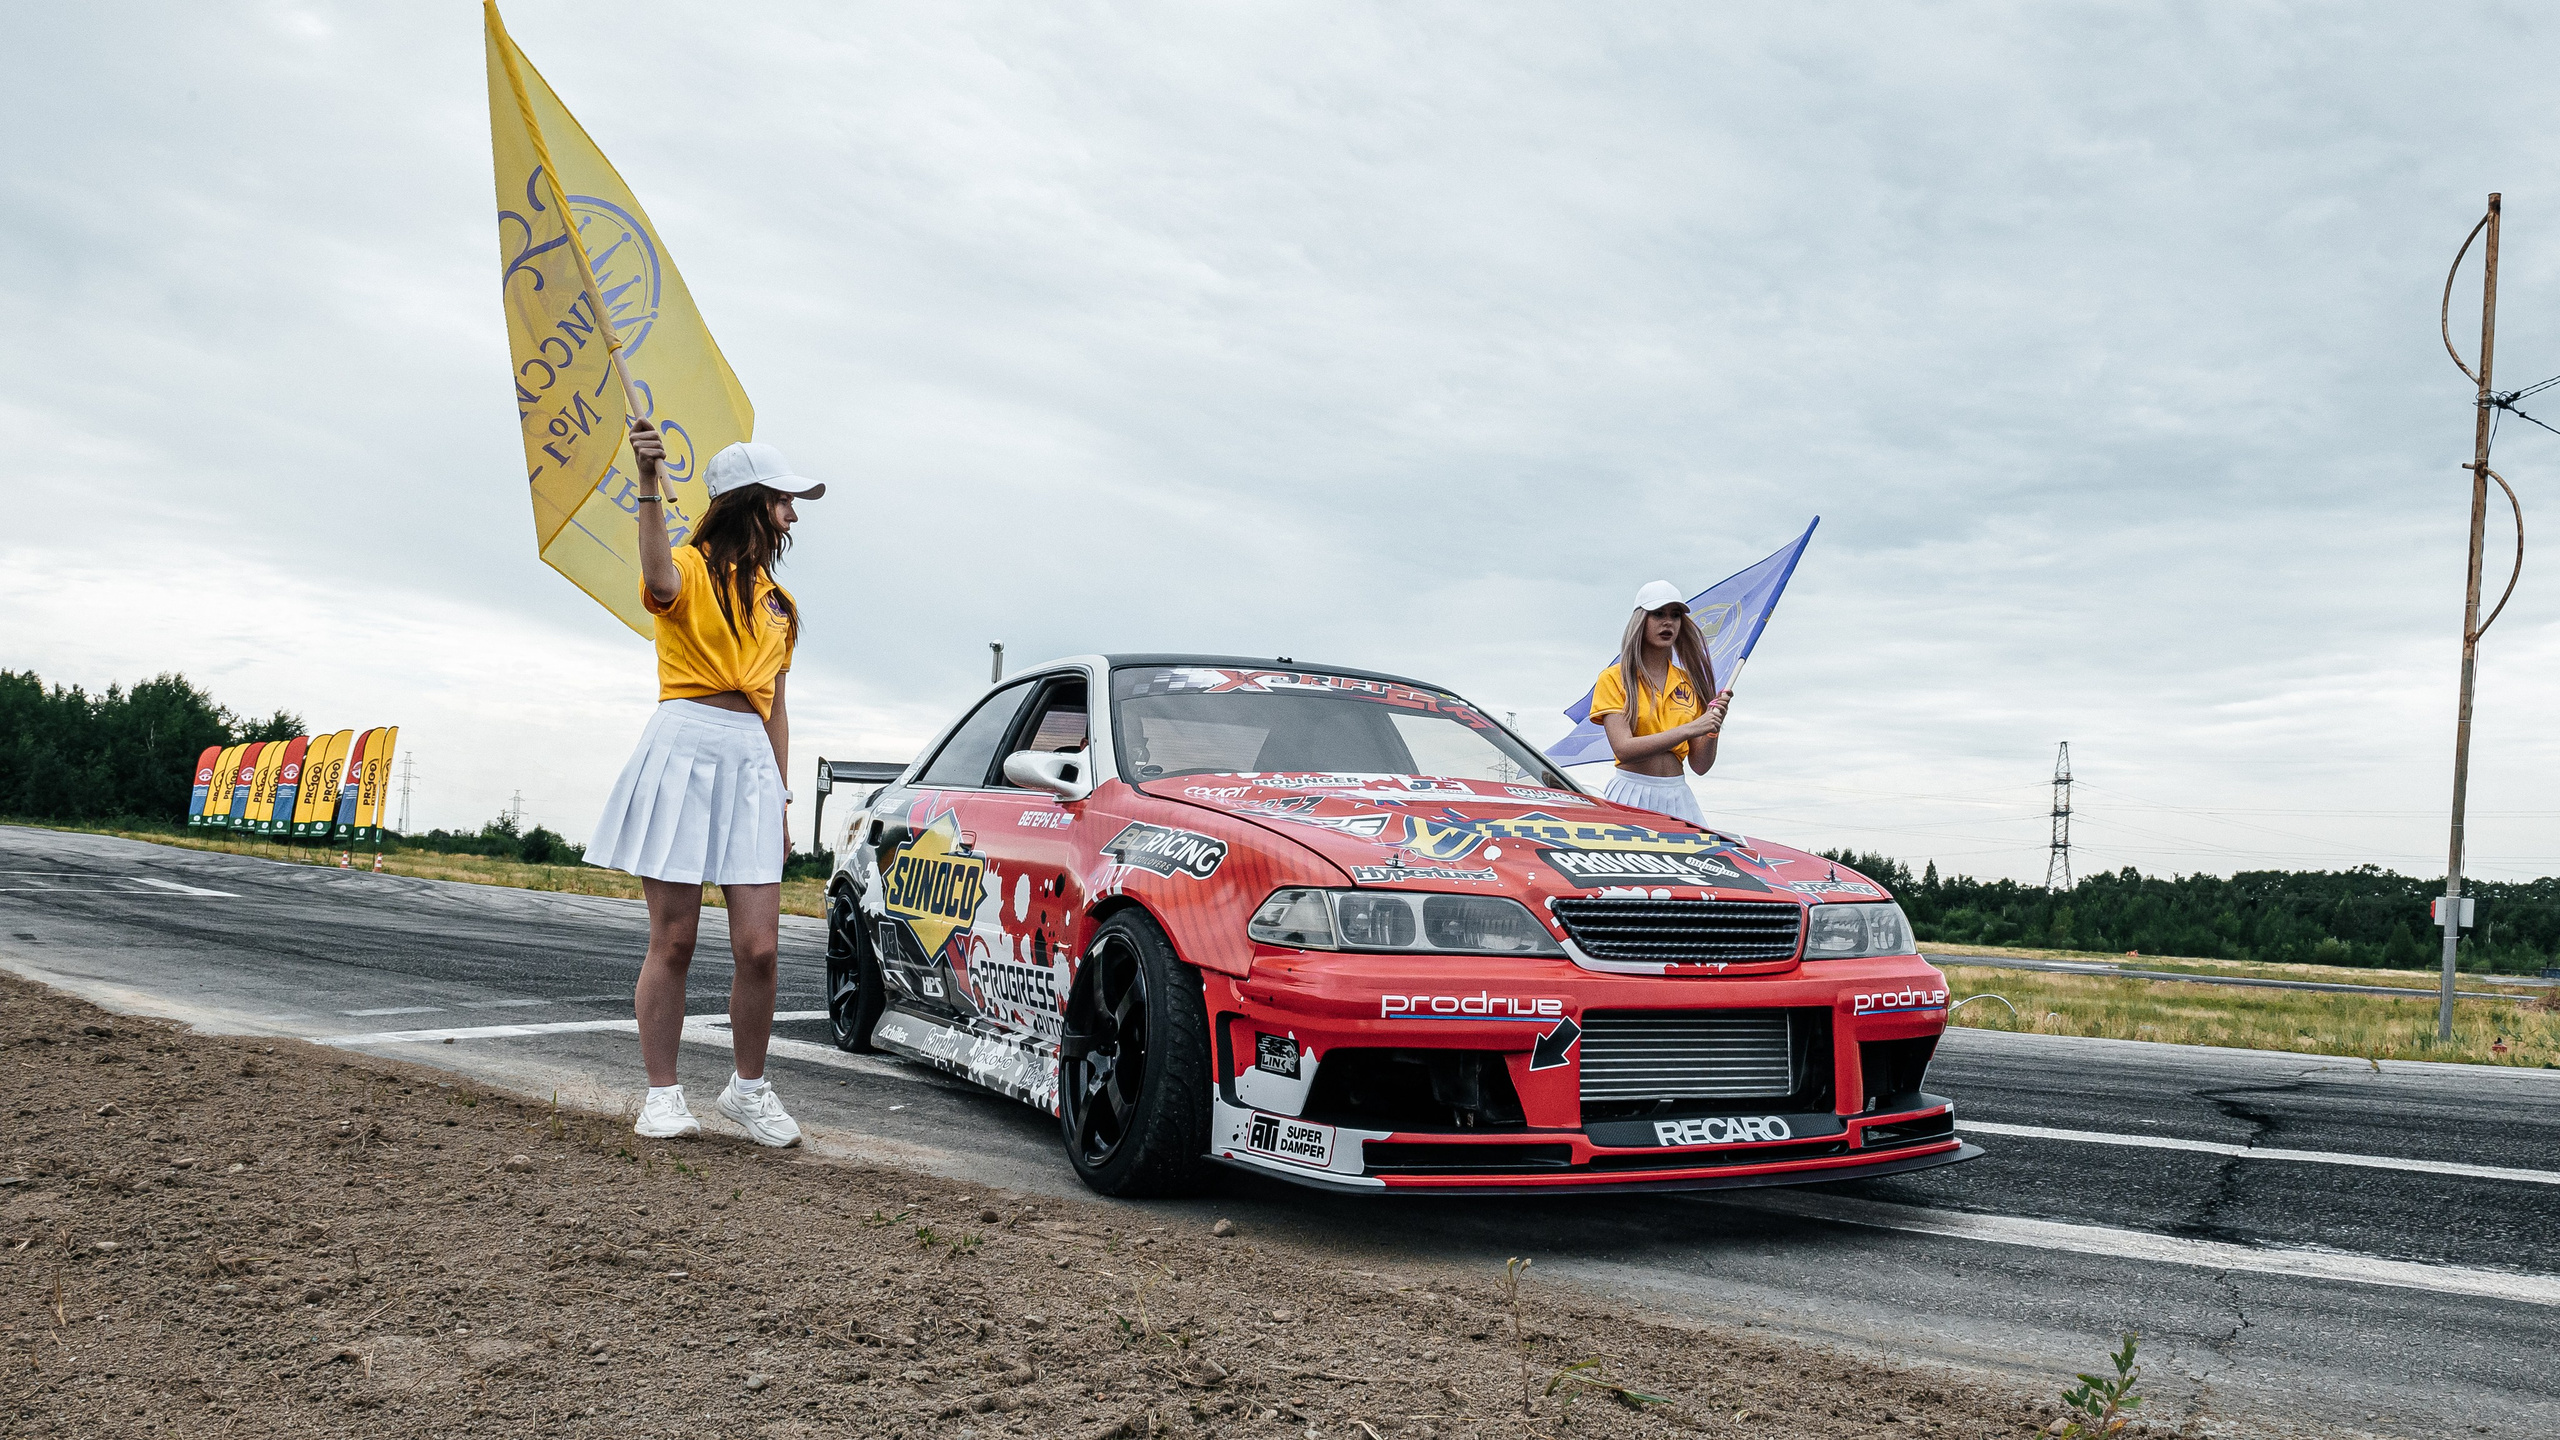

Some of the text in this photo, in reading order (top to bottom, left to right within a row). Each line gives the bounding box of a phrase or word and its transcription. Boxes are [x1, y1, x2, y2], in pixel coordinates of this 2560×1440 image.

[1184, 786, 1252, 798] COCKPIT
[1254, 777, 1359, 786] HOLINGER
[1017, 810, 1053, 828] ВЕГЕРЯ
[1351, 866, 1498, 882] Hypertune
[1550, 852, 1702, 875] PROVODA
[888, 856, 980, 921] SUNOCO
[980, 960, 1058, 1013] PROGRESS
[1381, 990, 1563, 1018] prodrive
[1853, 985, 1946, 1016] prodrive
[1250, 1115, 1280, 1152] ATI
[1286, 1125, 1322, 1144] SUPER
[1653, 1116, 1791, 1147] RECARO
[1280, 1139, 1325, 1159] DAMPER
